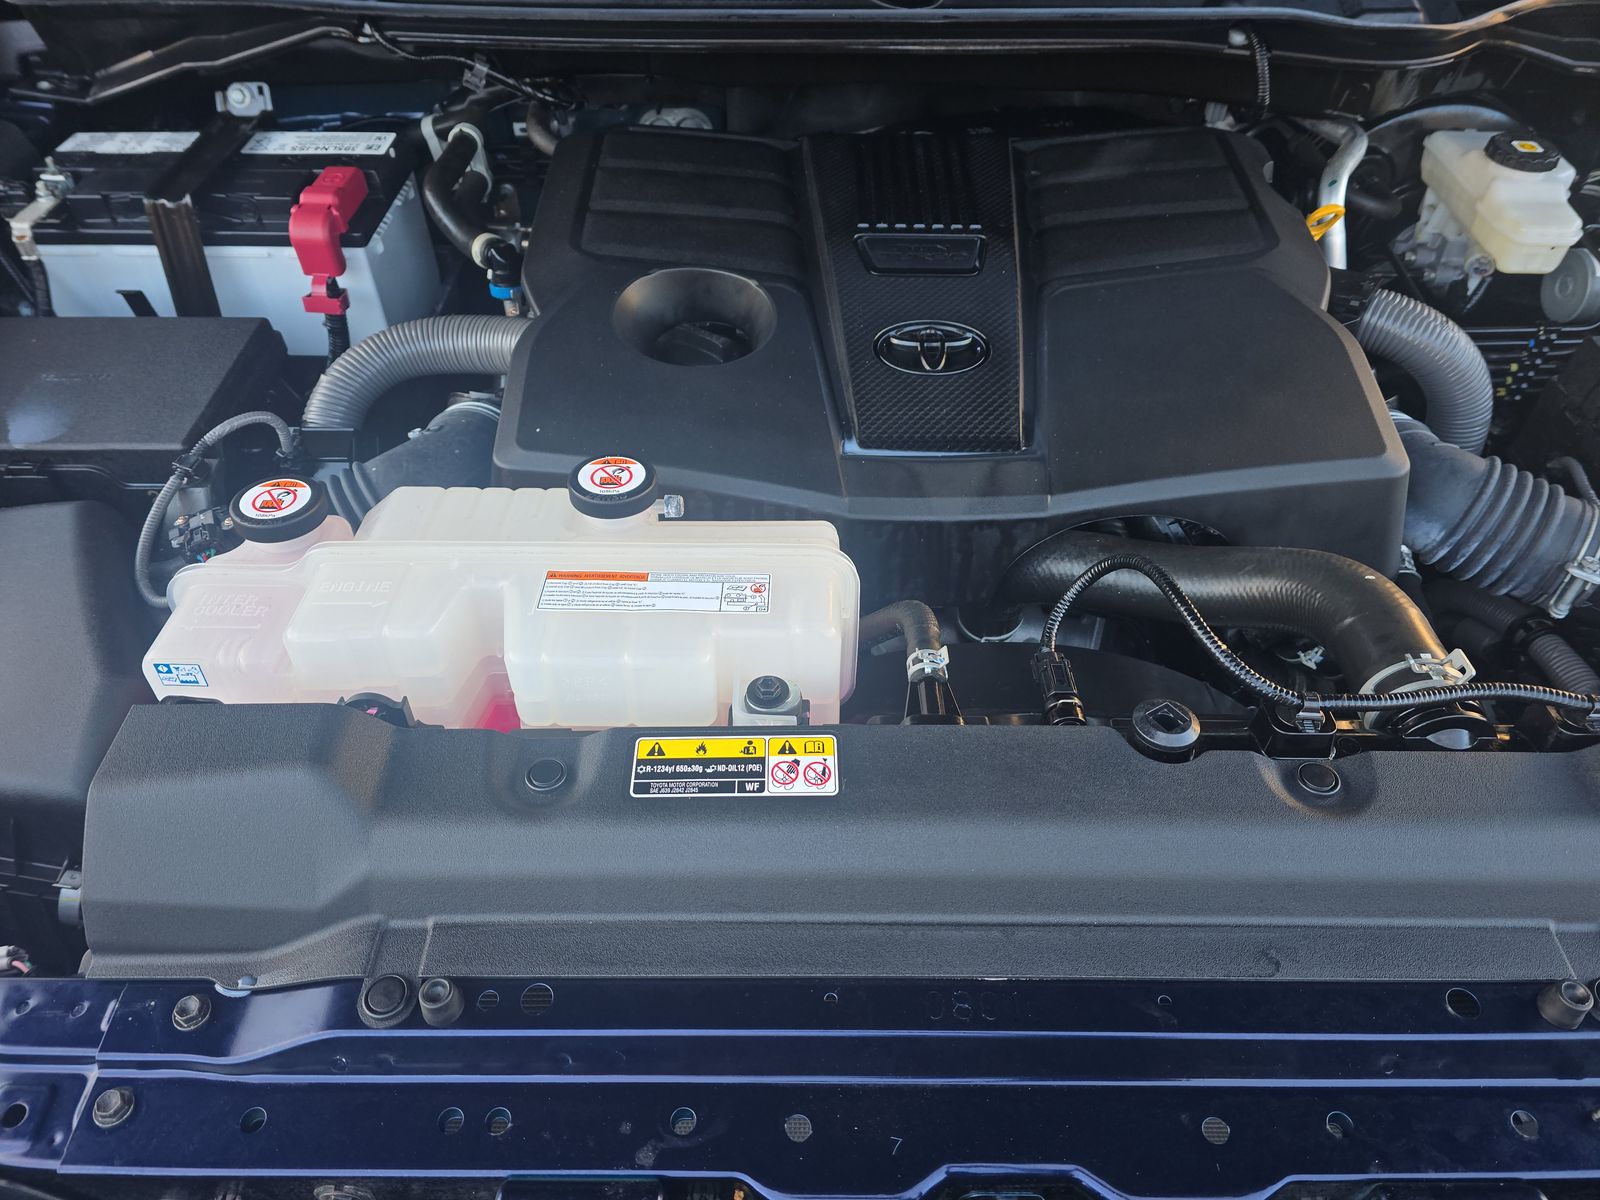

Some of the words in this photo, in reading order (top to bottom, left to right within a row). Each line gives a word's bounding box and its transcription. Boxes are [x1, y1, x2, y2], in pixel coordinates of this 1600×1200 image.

[319, 581, 392, 593] ENGINE
[646, 765, 675, 773] R-1234yf
[717, 764, 745, 772] ND-OIL12
[745, 764, 763, 773] (POE)
[745, 782, 760, 792] WF
